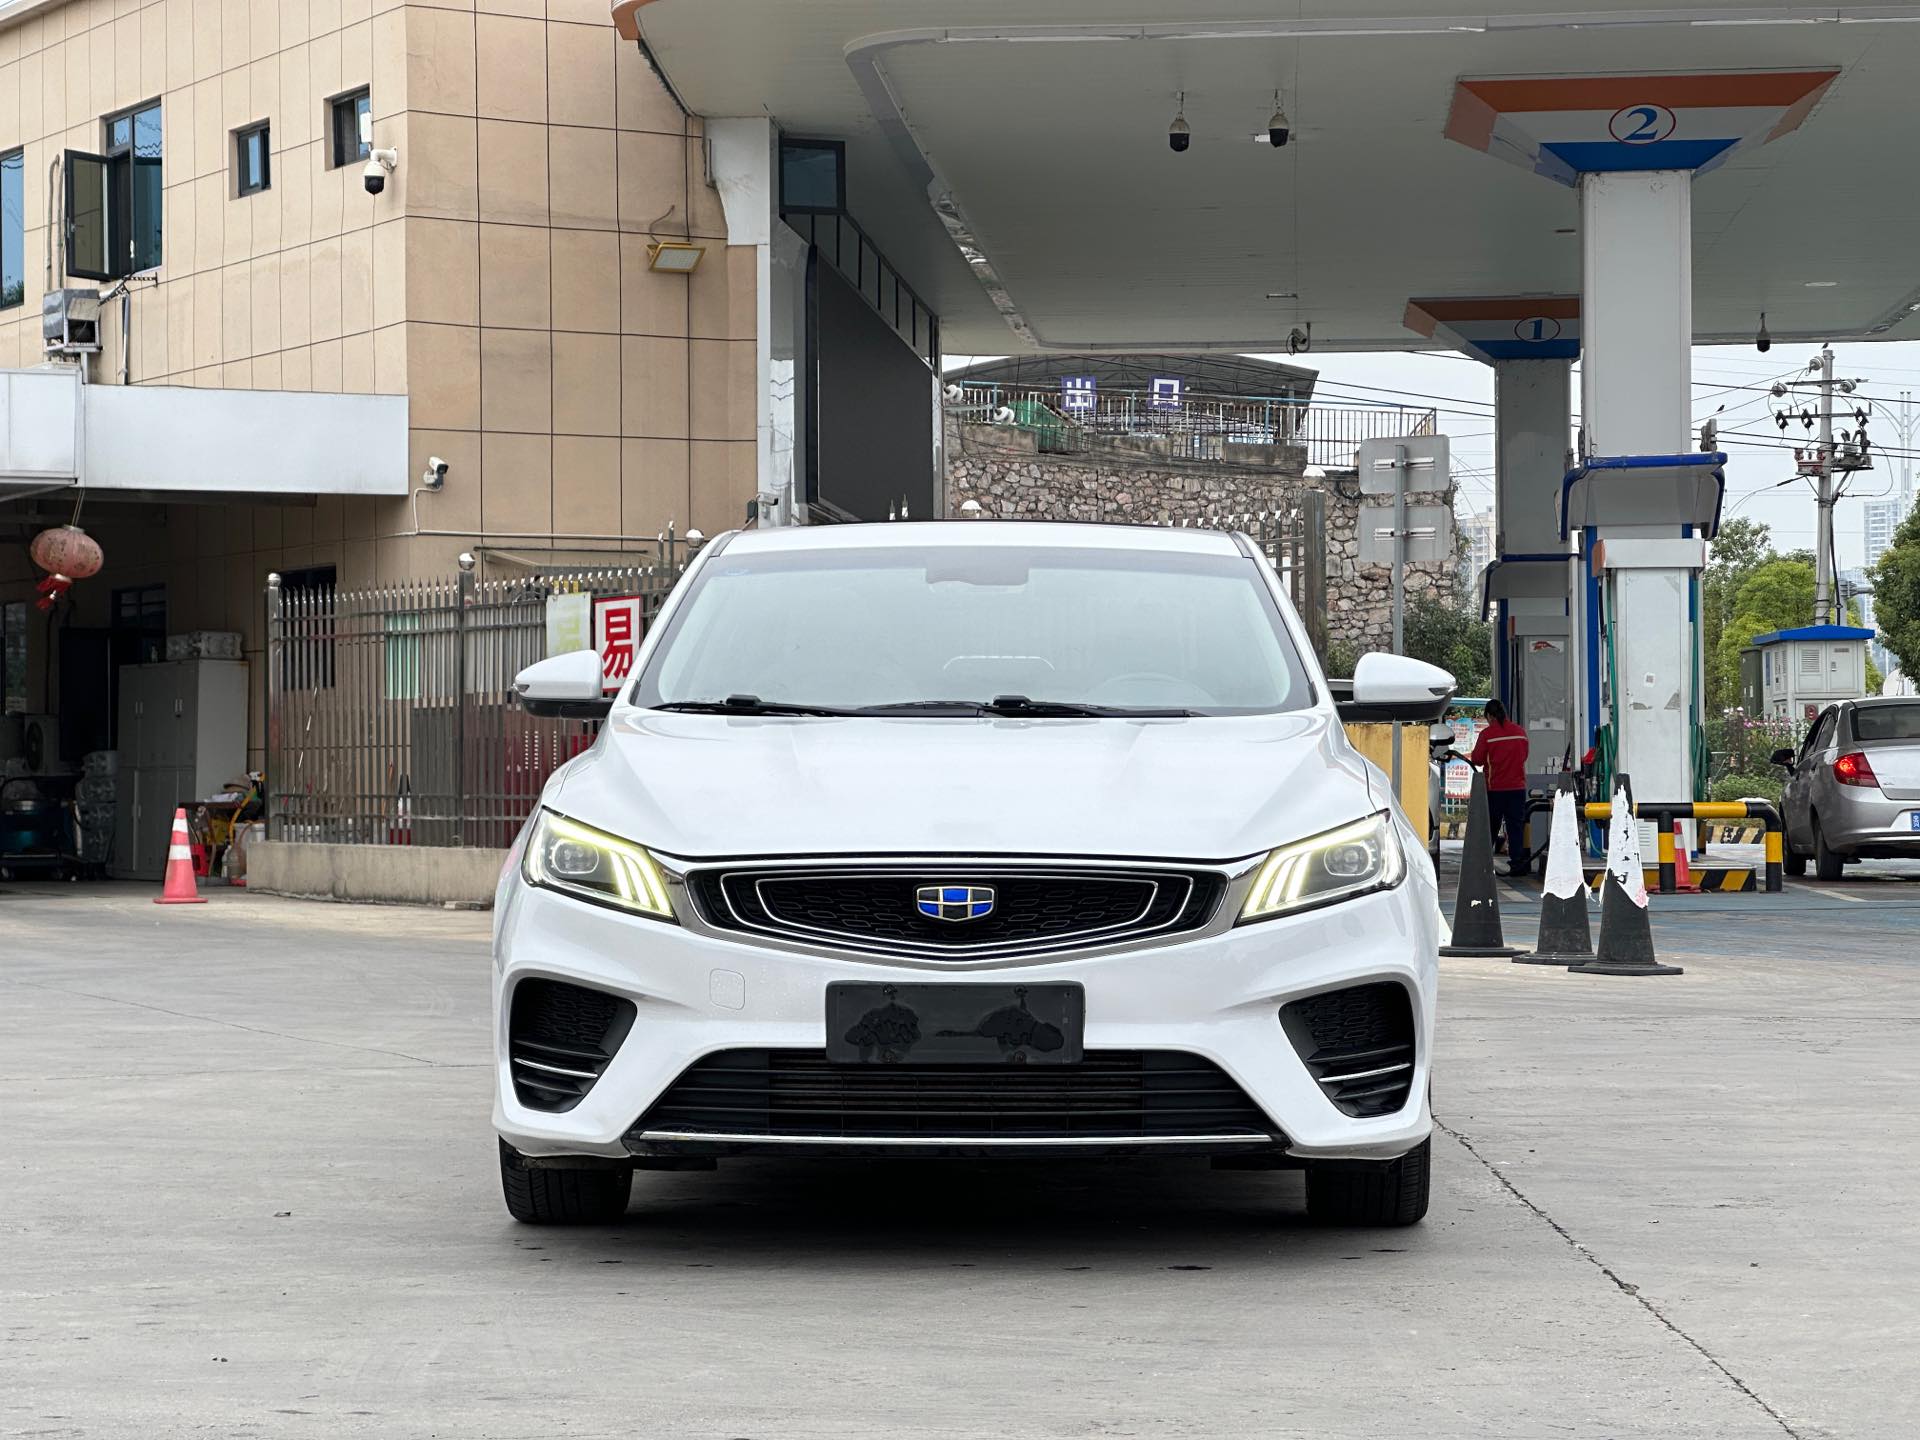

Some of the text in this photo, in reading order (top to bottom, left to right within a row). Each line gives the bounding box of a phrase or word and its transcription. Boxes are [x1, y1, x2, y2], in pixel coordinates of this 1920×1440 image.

[1623, 107, 1658, 141] 2
[1528, 319, 1543, 340] 1
[602, 607, 634, 680] 易
